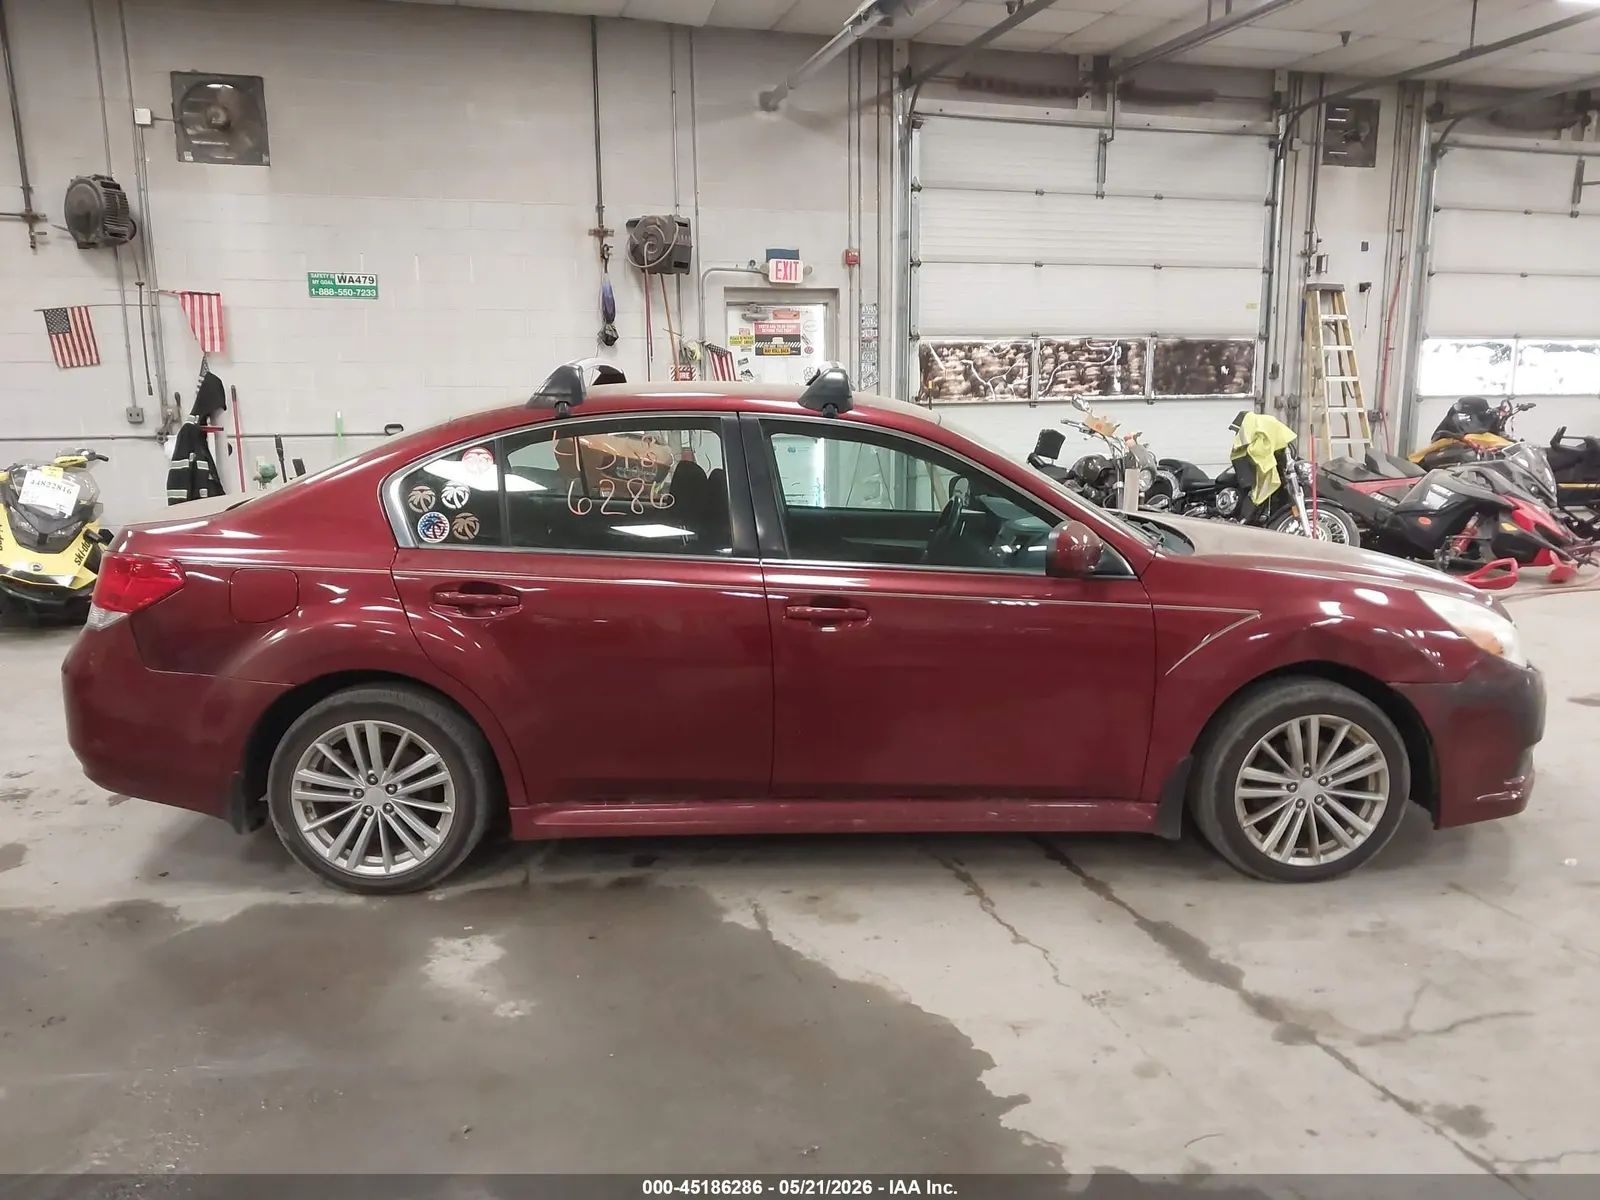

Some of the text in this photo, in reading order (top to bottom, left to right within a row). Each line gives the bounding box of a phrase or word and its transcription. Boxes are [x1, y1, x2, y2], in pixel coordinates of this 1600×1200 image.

[337, 275, 375, 284] WA479
[775, 260, 799, 280] EXIT
[311, 287, 376, 296] 1-888-550-7233
[567, 477, 675, 515] 6286
[74, 540, 91, 566] ski-do
